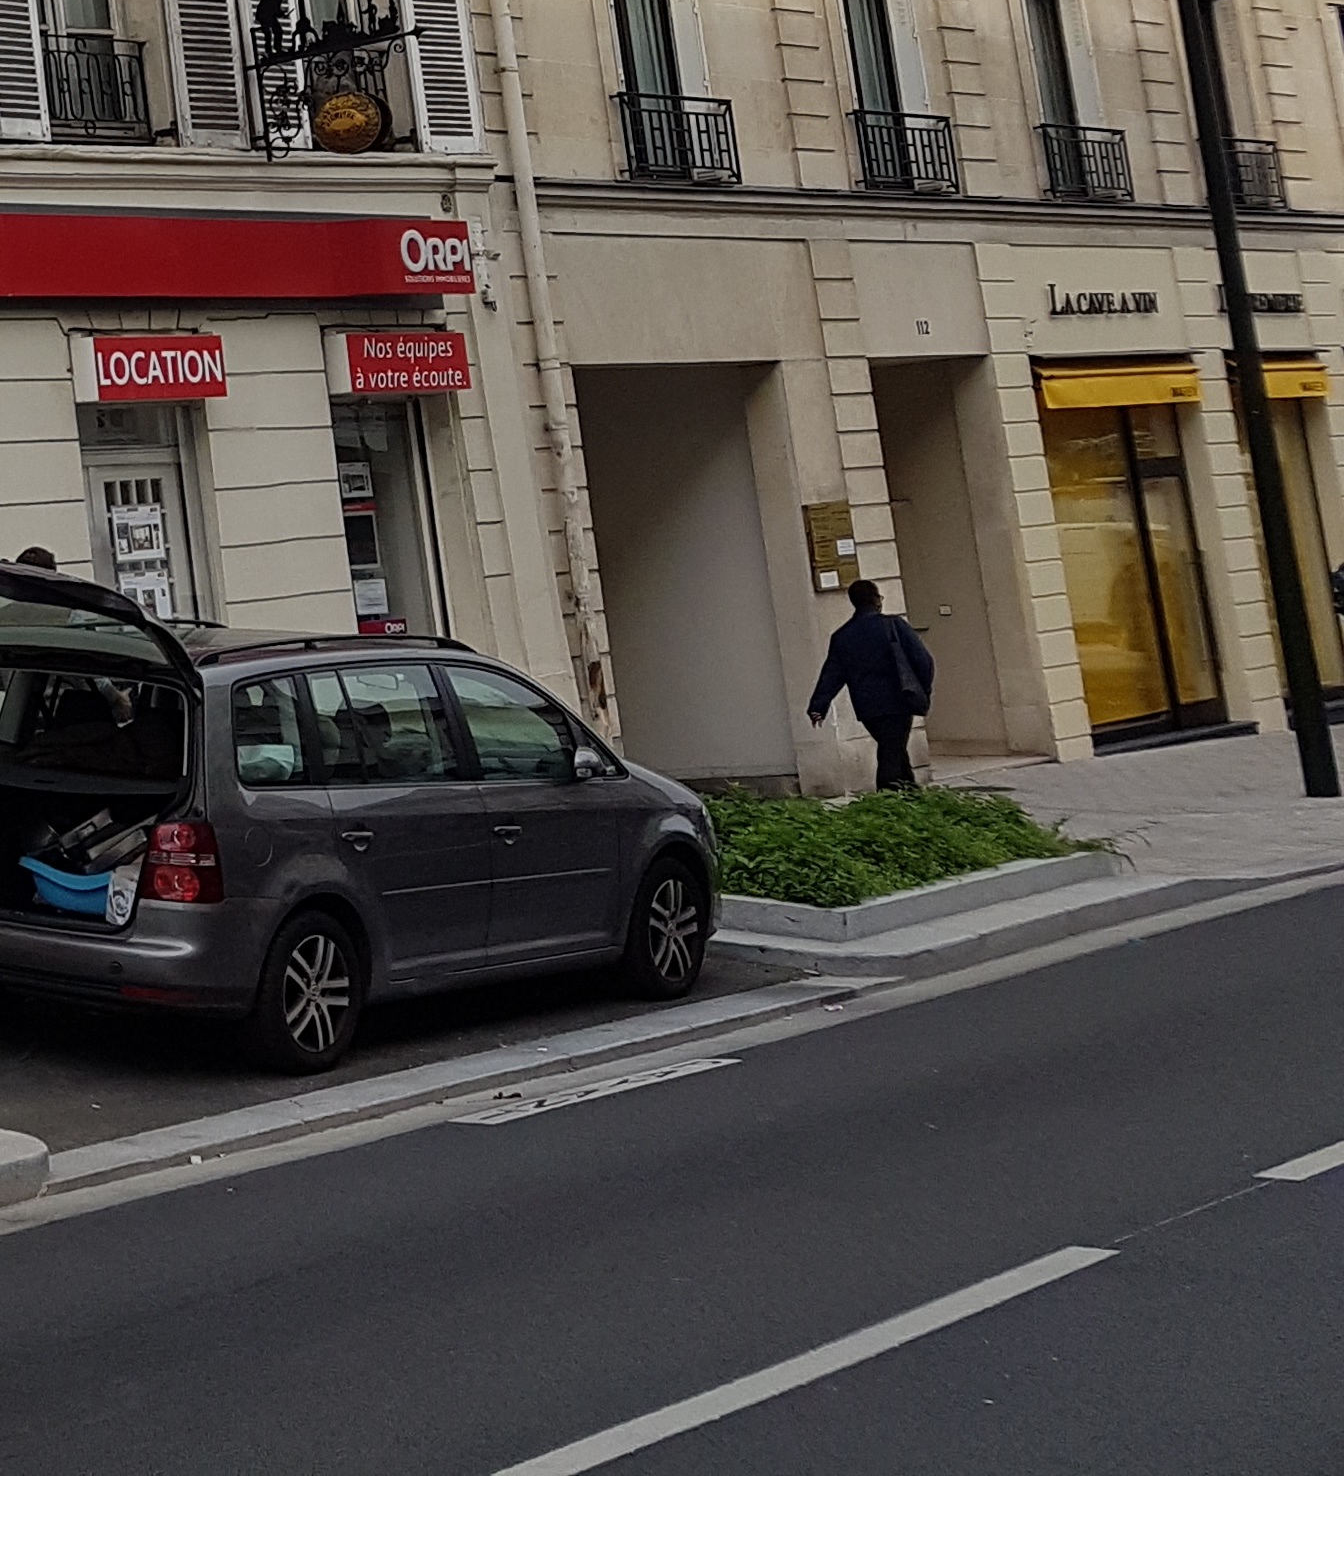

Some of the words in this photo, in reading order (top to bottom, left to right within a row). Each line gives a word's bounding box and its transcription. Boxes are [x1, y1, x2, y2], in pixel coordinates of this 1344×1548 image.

[400, 229, 471, 273] ORPI
[1130, 292, 1159, 314] VIN
[916, 320, 930, 334] 112
[363, 337, 392, 357] Nos
[396, 336, 452, 363] équipes
[97, 349, 224, 387] LOCATION
[356, 366, 365, 388] à
[368, 369, 409, 388] votre
[412, 366, 466, 387] écoute.
